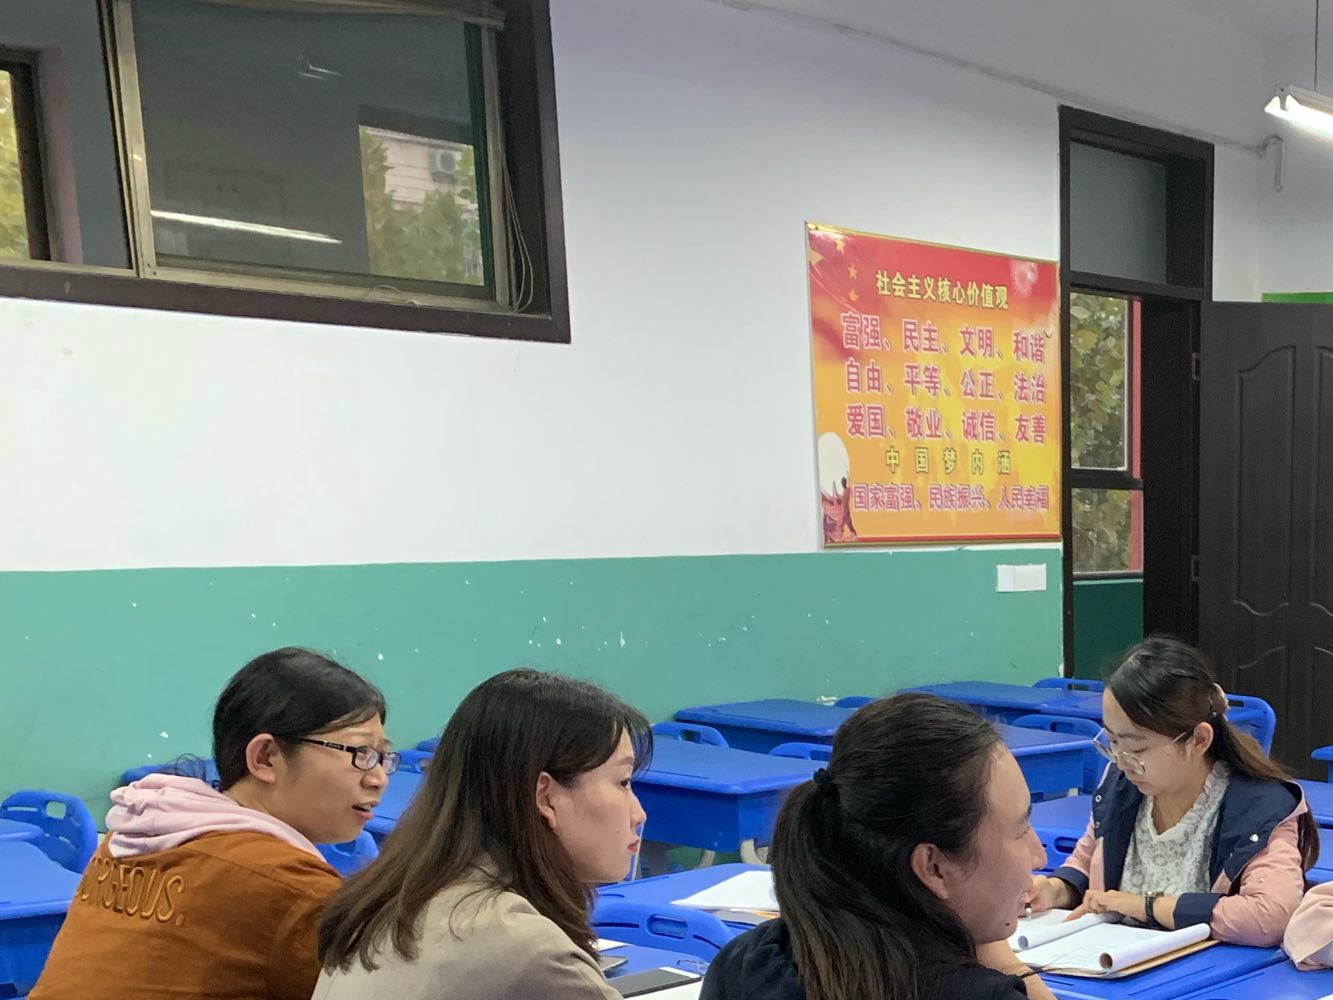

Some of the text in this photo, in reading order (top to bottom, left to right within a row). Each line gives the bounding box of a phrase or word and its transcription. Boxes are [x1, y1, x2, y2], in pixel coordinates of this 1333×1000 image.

[876, 270, 1009, 309] 社会主义核心价值观
